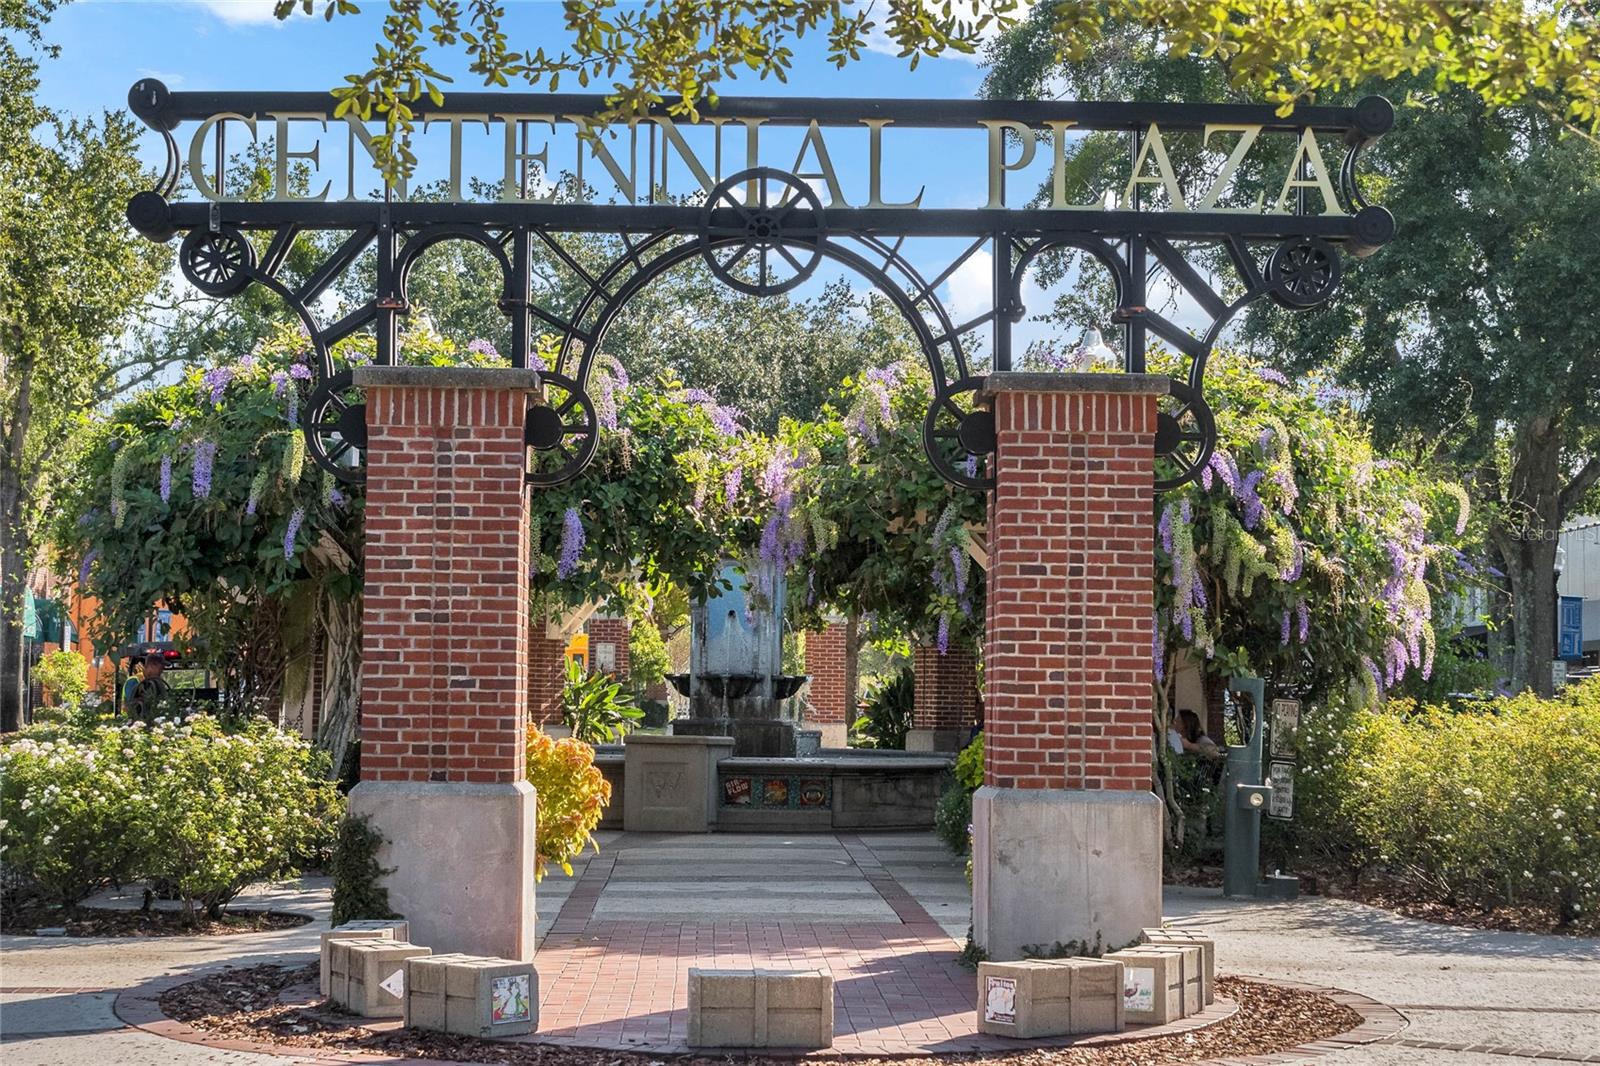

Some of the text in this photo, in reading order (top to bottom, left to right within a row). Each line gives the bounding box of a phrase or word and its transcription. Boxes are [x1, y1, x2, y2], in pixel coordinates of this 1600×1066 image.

[189, 111, 1352, 216] CENTENNIAL PLAZA
[727, 782, 749, 795] FLOW
